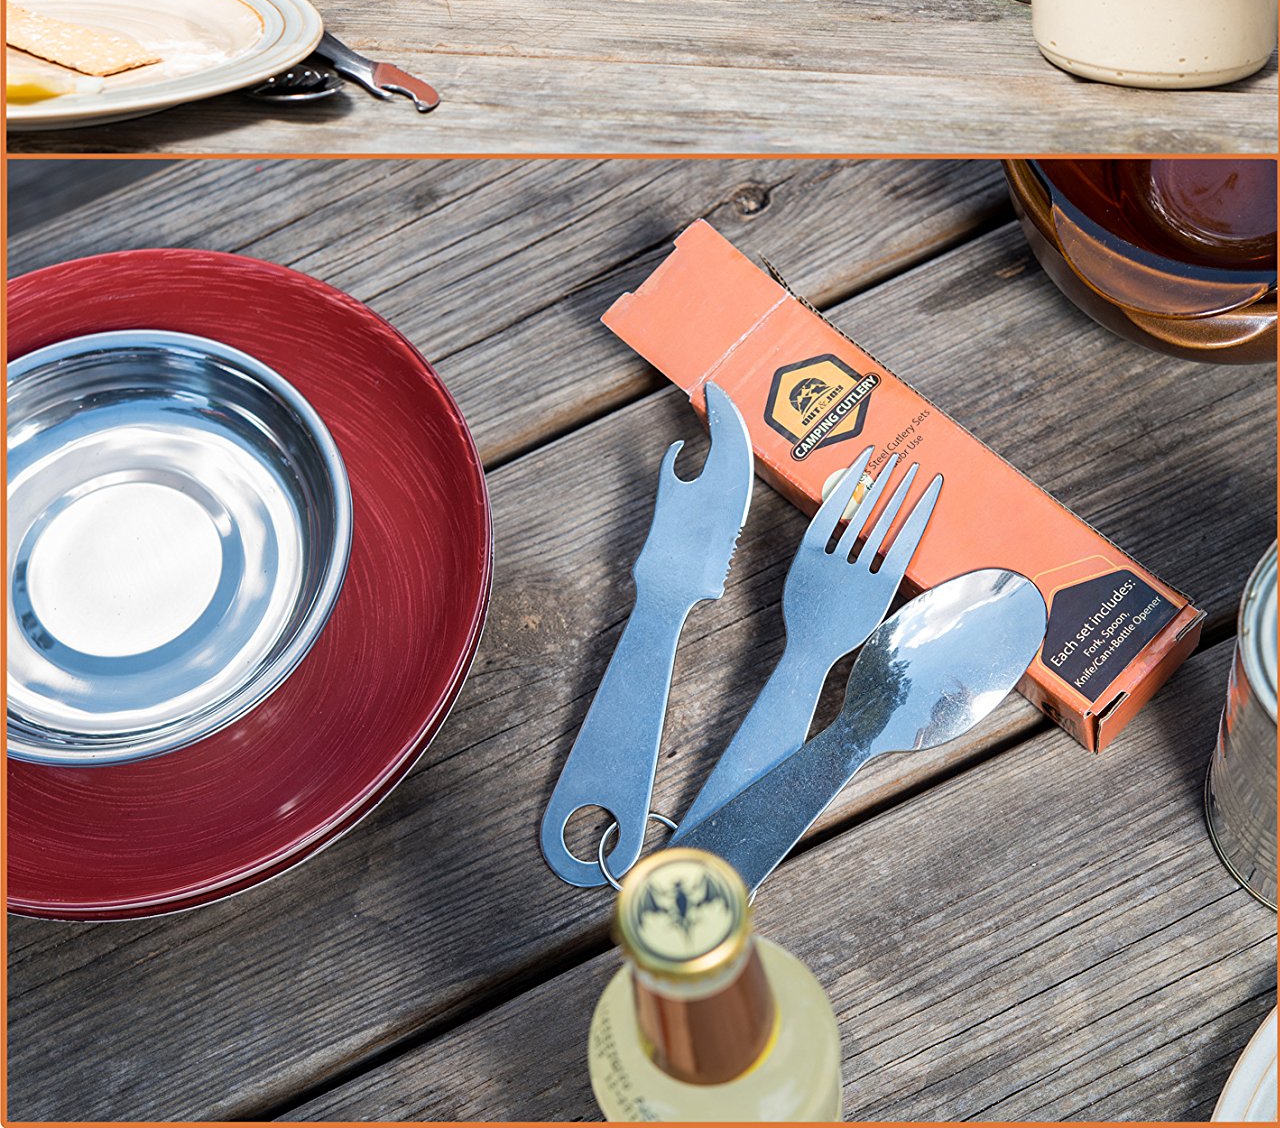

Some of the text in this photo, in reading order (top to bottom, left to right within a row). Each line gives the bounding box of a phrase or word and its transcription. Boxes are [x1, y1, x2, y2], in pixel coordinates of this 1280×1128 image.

[795, 374, 878, 458] CAMPING CUTLERY
[868, 448, 890, 470] Steel
[886, 424, 915, 452] Cutlery
[911, 409, 930, 426] Sets
[906, 434, 924, 450] Use
[1050, 578, 1136, 668] Each set includes:
[1073, 595, 1162, 689] Knife/Can+Bottle Opener
[1083, 611, 1130, 658] Fork, Spoon,
